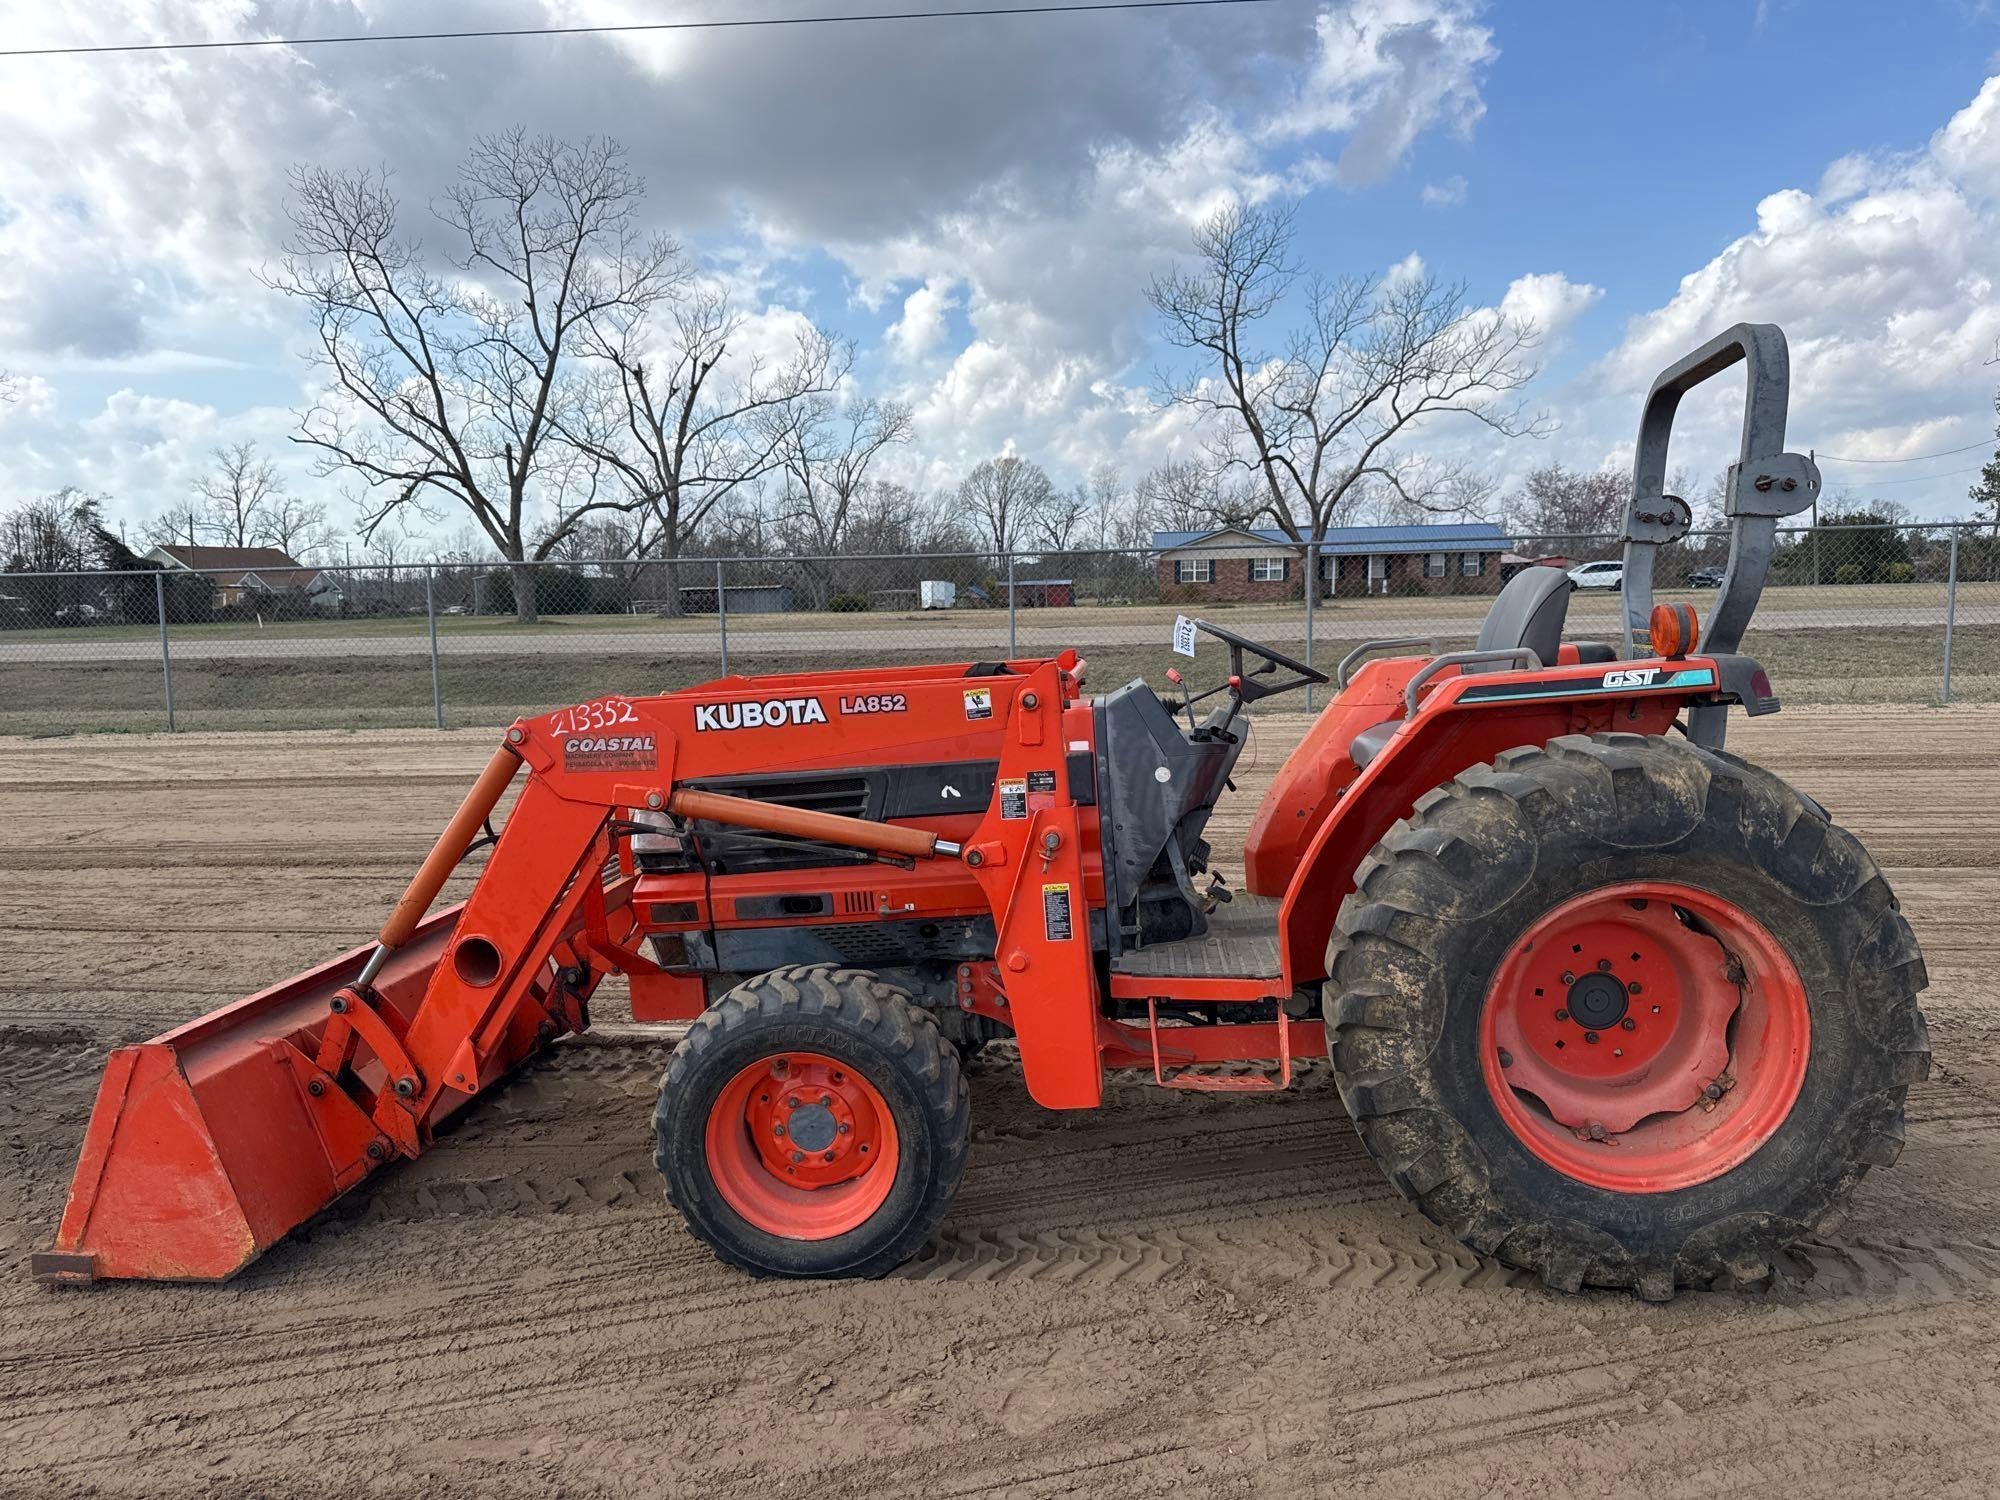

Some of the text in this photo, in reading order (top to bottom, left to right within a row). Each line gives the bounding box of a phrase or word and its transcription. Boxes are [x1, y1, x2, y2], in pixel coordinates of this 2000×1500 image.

[1602, 668, 1661, 688] GST
[694, 697, 829, 732] KUBOTA
[840, 694, 907, 715] LA852
[550, 700, 639, 738] 213352
[564, 736, 656, 753] COASTAL
